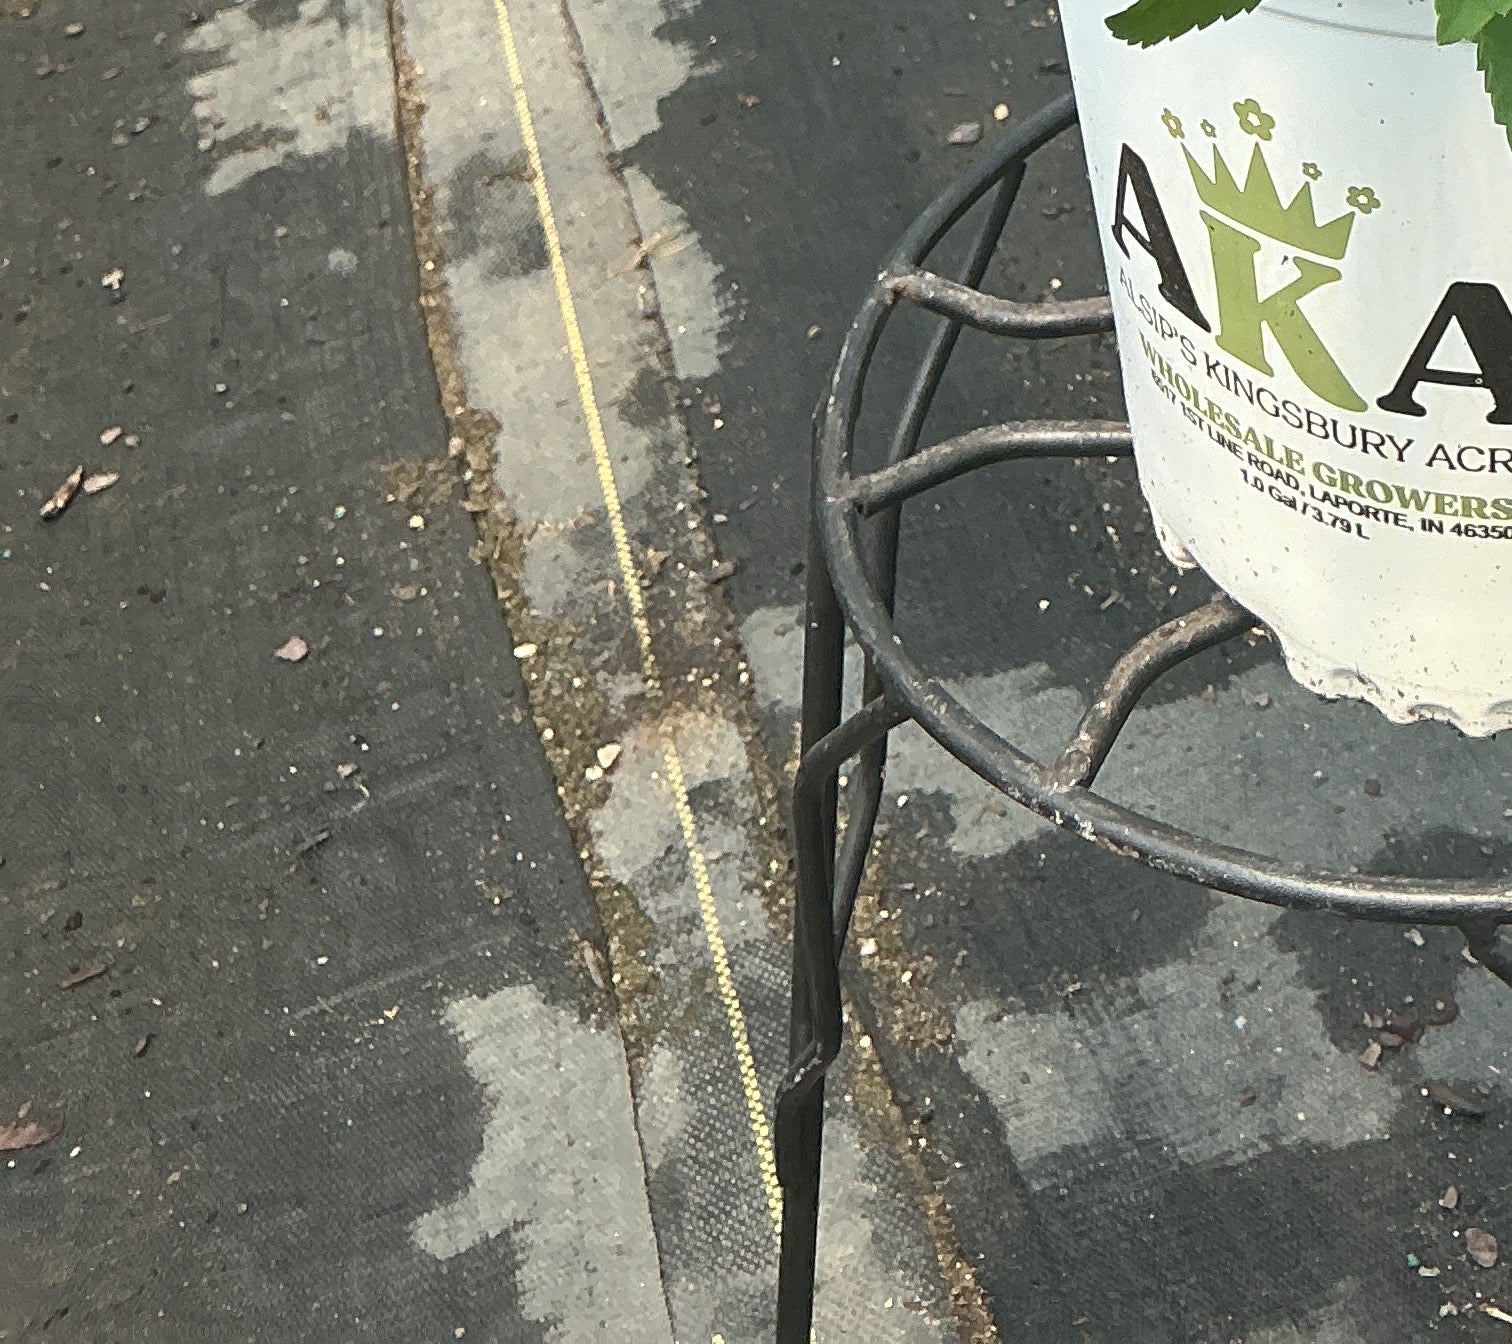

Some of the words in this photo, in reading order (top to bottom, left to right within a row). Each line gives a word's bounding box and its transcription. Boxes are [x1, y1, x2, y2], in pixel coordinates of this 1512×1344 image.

[1119, 266, 1198, 366] ALSIP'S
[1204, 352, 1415, 463] KINGSBURY
[1138, 328, 1306, 476] WHOLESALE
[1207, 424, 1245, 462] LINE
[1309, 484, 1415, 532] LAPORTE,
[1420, 517, 1445, 535] IN
[1240, 467, 1265, 493] 1.0
[1268, 484, 1298, 512] Gal
[1311, 505, 1352, 534] 3.79
[1355, 522, 1371, 540] L
